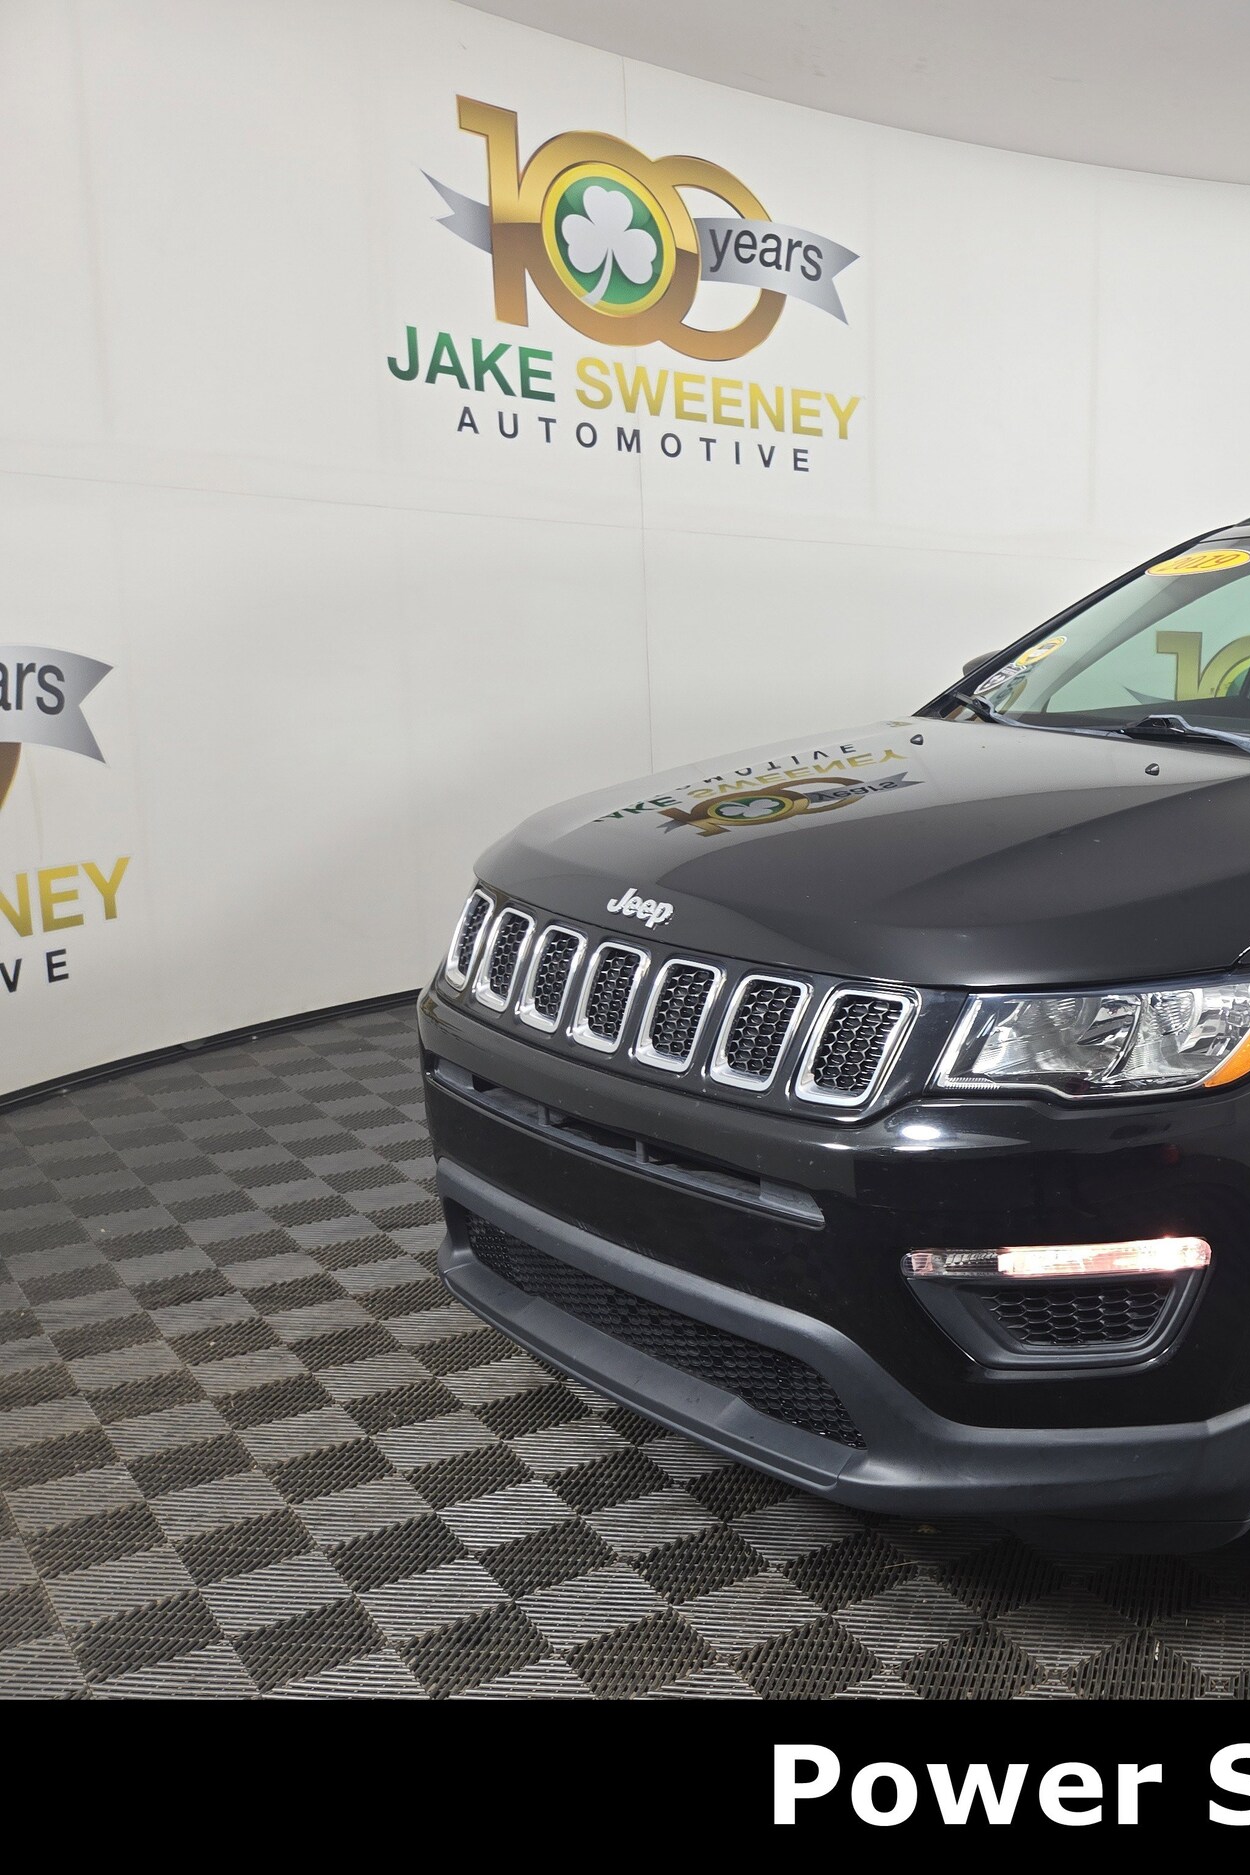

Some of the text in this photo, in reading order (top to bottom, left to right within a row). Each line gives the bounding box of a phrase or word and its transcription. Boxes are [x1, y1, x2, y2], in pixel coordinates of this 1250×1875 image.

[709, 226, 824, 282] years
[387, 326, 860, 440] JAKE SWEENEY
[457, 406, 810, 473] AUTOMOTIVE
[606, 887, 674, 929] Jeep
